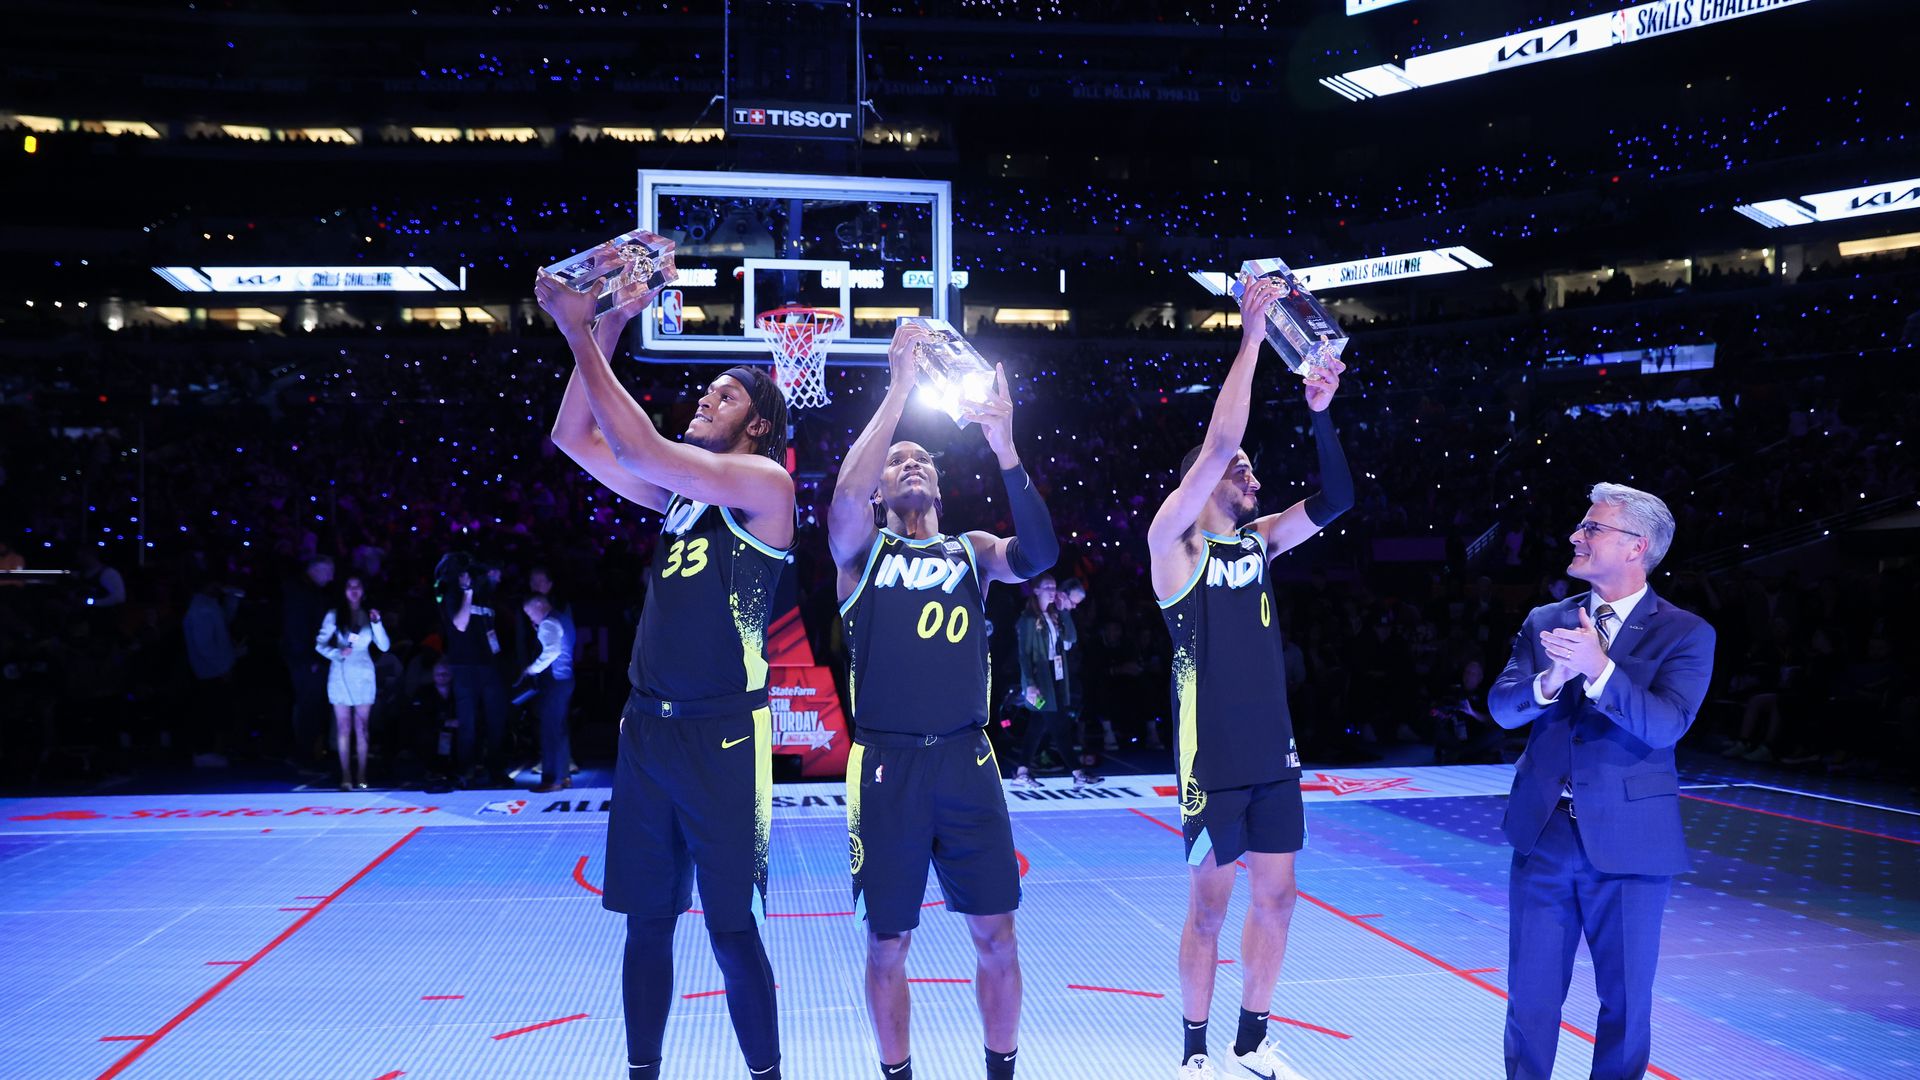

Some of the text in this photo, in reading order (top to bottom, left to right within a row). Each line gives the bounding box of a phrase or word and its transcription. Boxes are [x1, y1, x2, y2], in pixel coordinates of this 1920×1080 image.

[1498, 29, 1577, 61] KIA
[767, 110, 851, 128] TISSOT
[1371, 257, 1421, 278] CHALLENGE
[661, 538, 709, 578] 33
[875, 554, 970, 594] INDY
[1206, 552, 1263, 589] INDY
[917, 601, 969, 643] 00
[1260, 592, 1271, 628] 0
[772, 711, 818, 732] TURDAY
[772, 795, 846, 807] SAT
[1008, 787, 1143, 801] NIGHT
